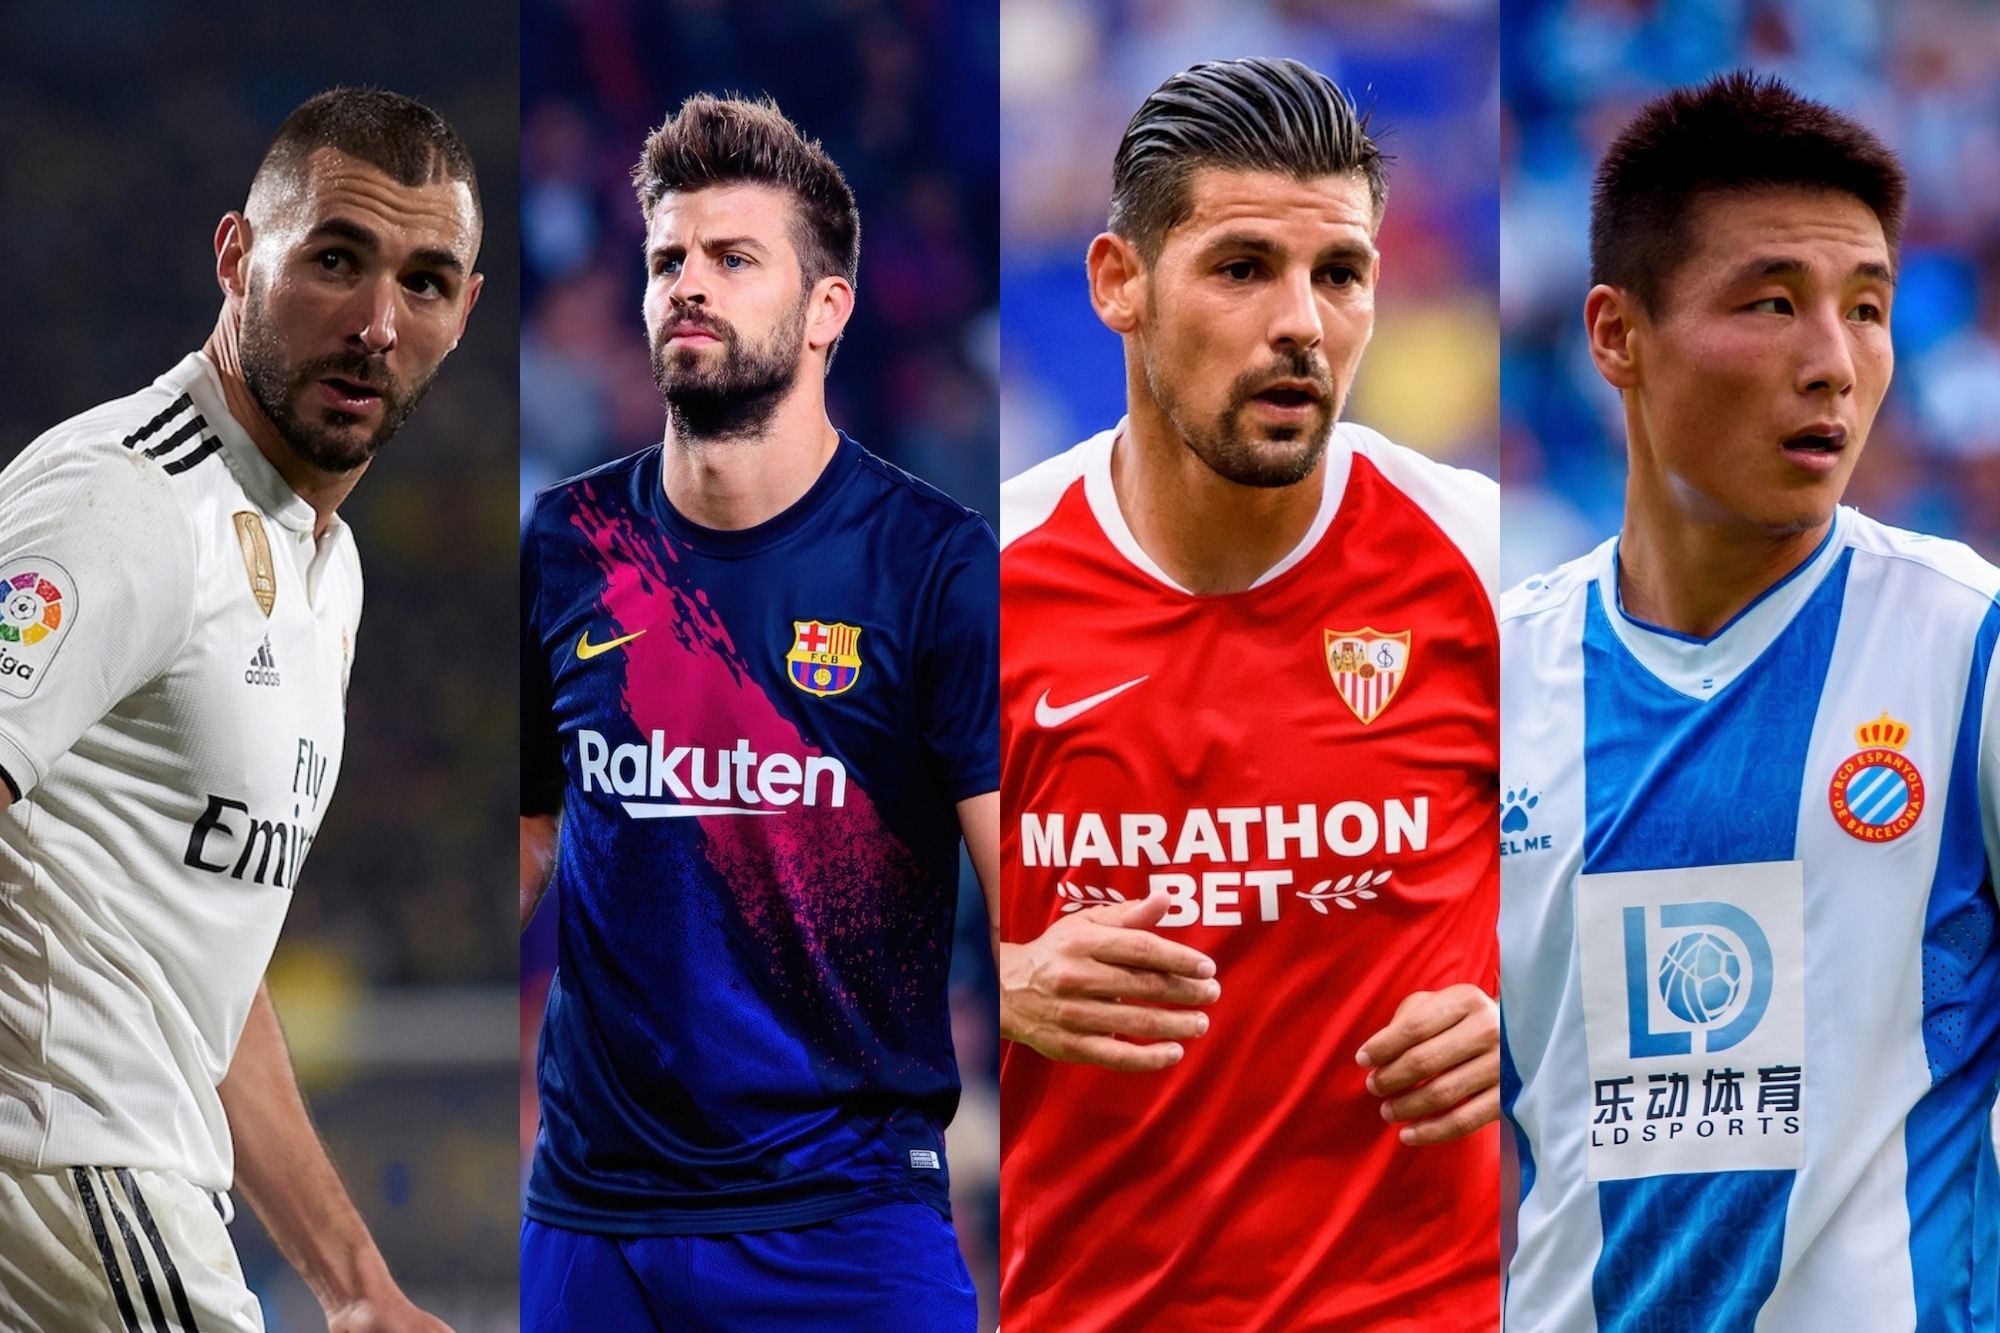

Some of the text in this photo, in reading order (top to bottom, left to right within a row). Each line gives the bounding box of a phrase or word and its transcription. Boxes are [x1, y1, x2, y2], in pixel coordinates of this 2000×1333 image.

[245, 670, 280, 687] adidas
[811, 653, 838, 664] FCB
[293, 737, 326, 812] Fly
[578, 729, 846, 808] Rakuten
[1833, 752, 1920, 791] RCD ESPANYOL
[1020, 797, 1428, 867] MARATHON
[1833, 800, 1920, 839] DE BARCELONA
[1148, 869, 1293, 927] BET
[1593, 1065, 1801, 1124] 乐动体育
[1592, 1116, 1799, 1147] LDSPORTS
